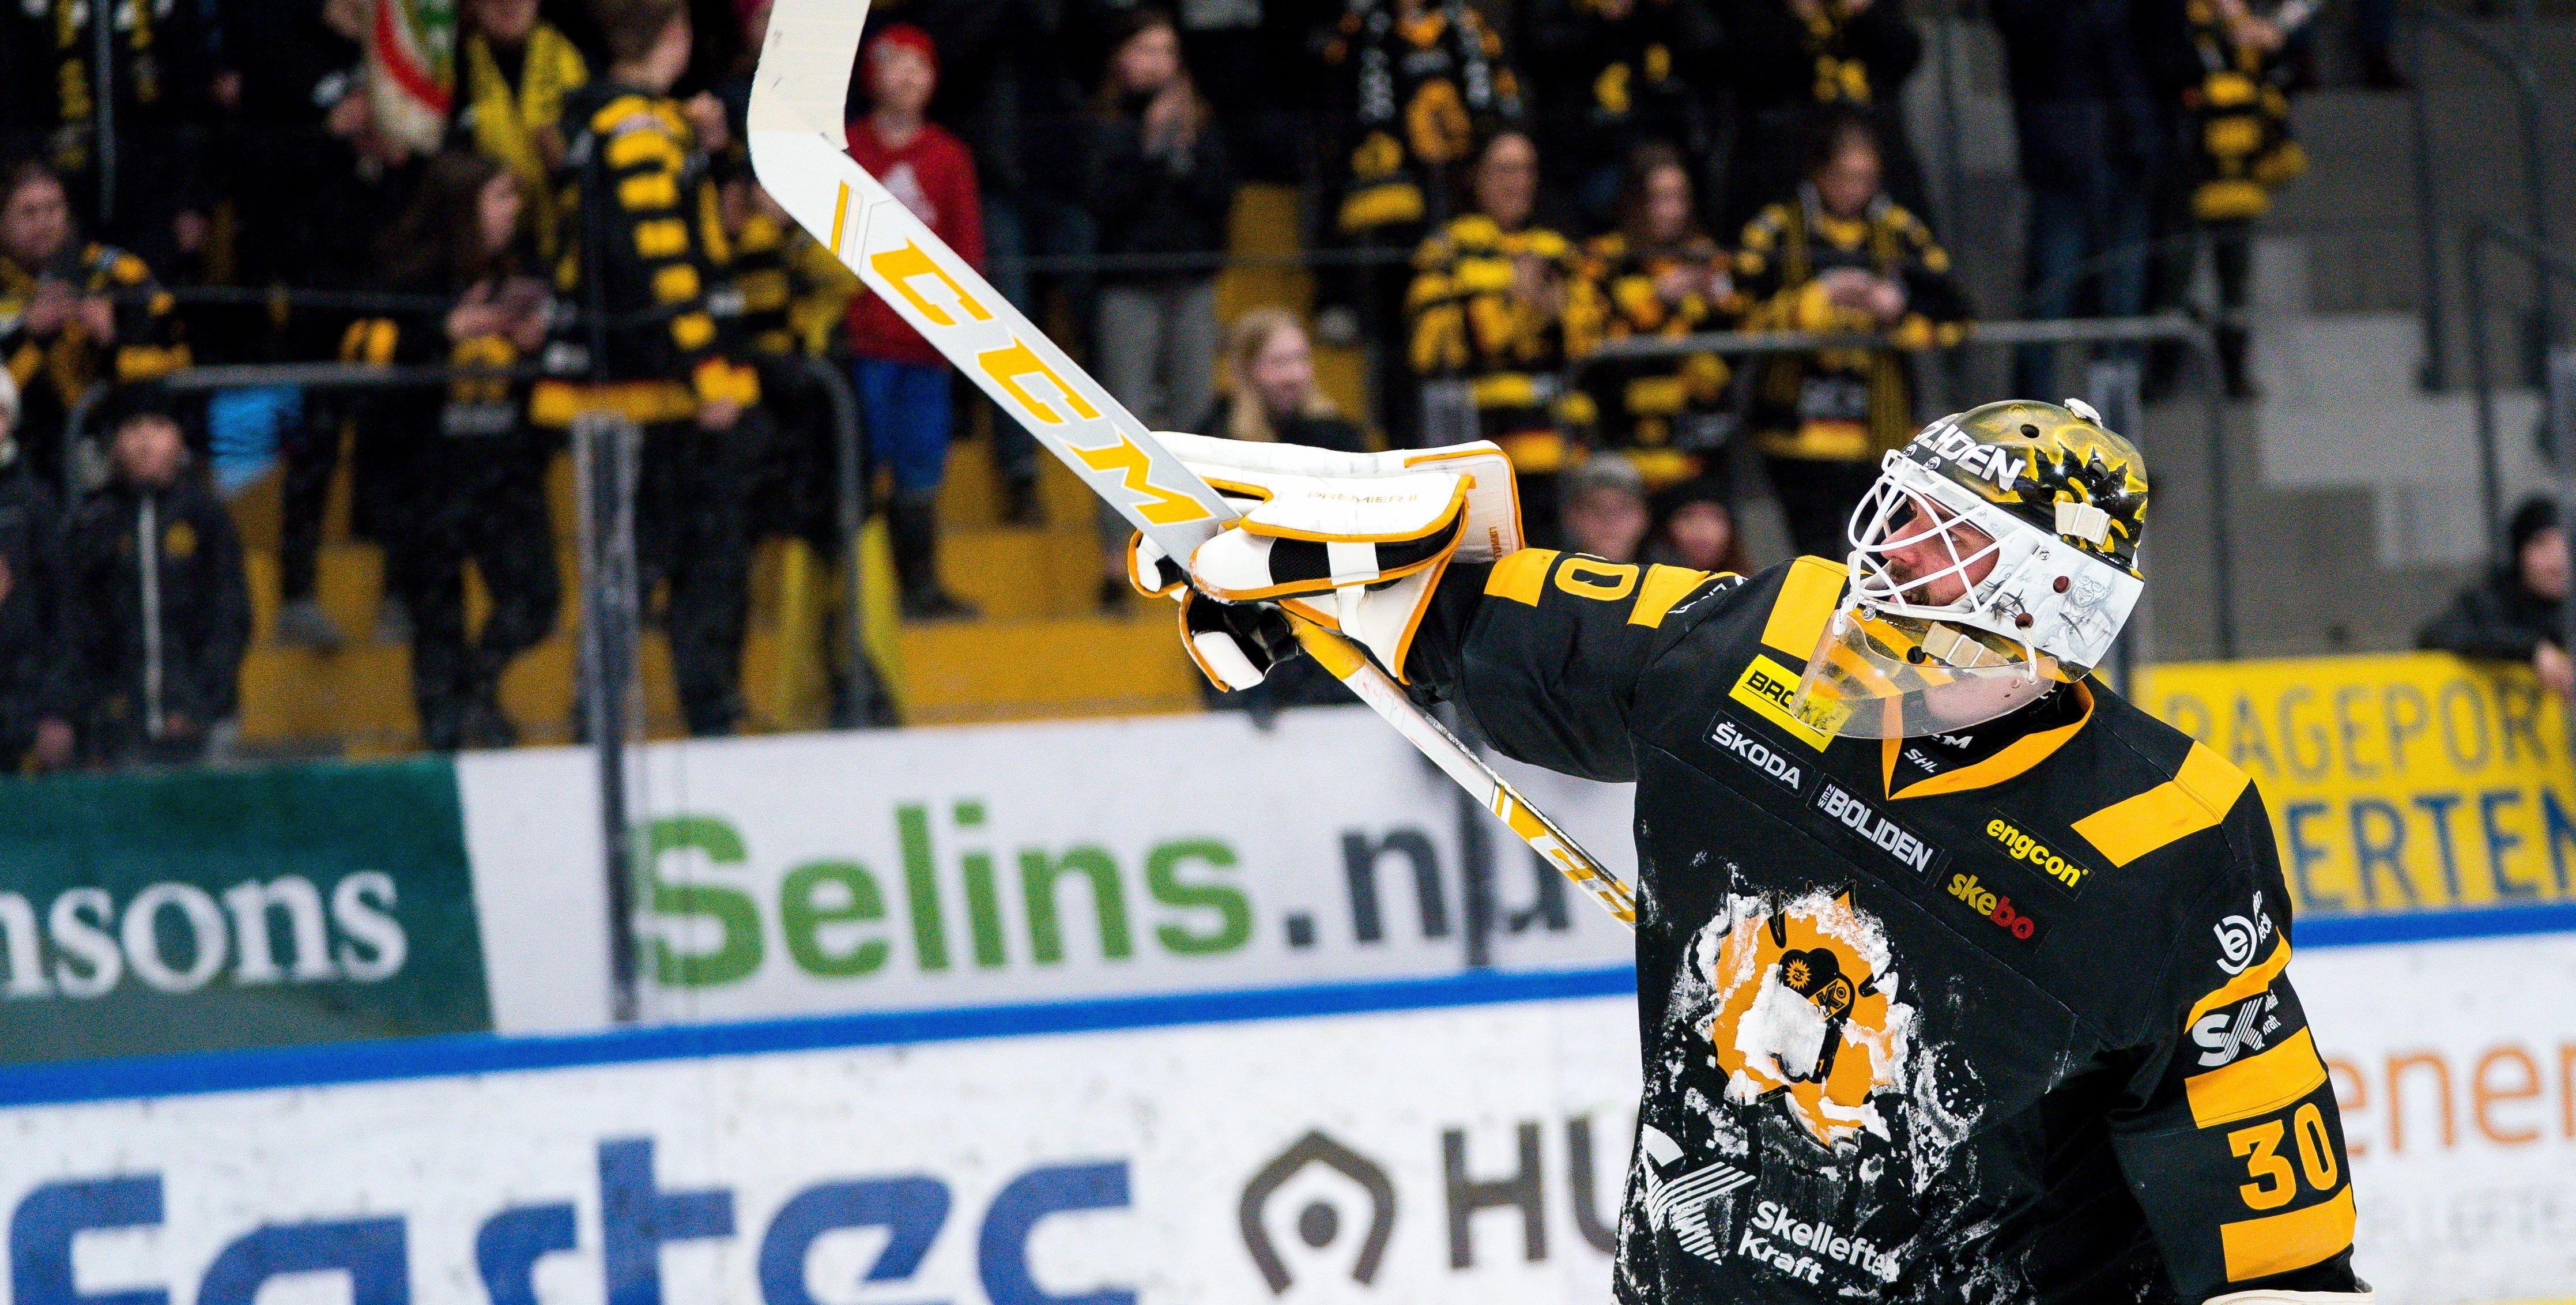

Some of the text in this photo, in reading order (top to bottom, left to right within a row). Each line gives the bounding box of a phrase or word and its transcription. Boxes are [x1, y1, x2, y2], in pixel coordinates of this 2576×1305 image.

[870, 237, 1213, 525] CCM
[1307, 492, 1404, 503] PREMIER
[1711, 721, 1800, 790] ŠKODA
[1904, 749, 1938, 773] SHL
[1817, 783, 1835, 808] NEW
[1824, 787, 1933, 873] BOLIDEN
[1947, 873, 2035, 940] skebo
[2227, 1102, 2337, 1210] 30
[1737, 1228, 1824, 1285] Kraft
